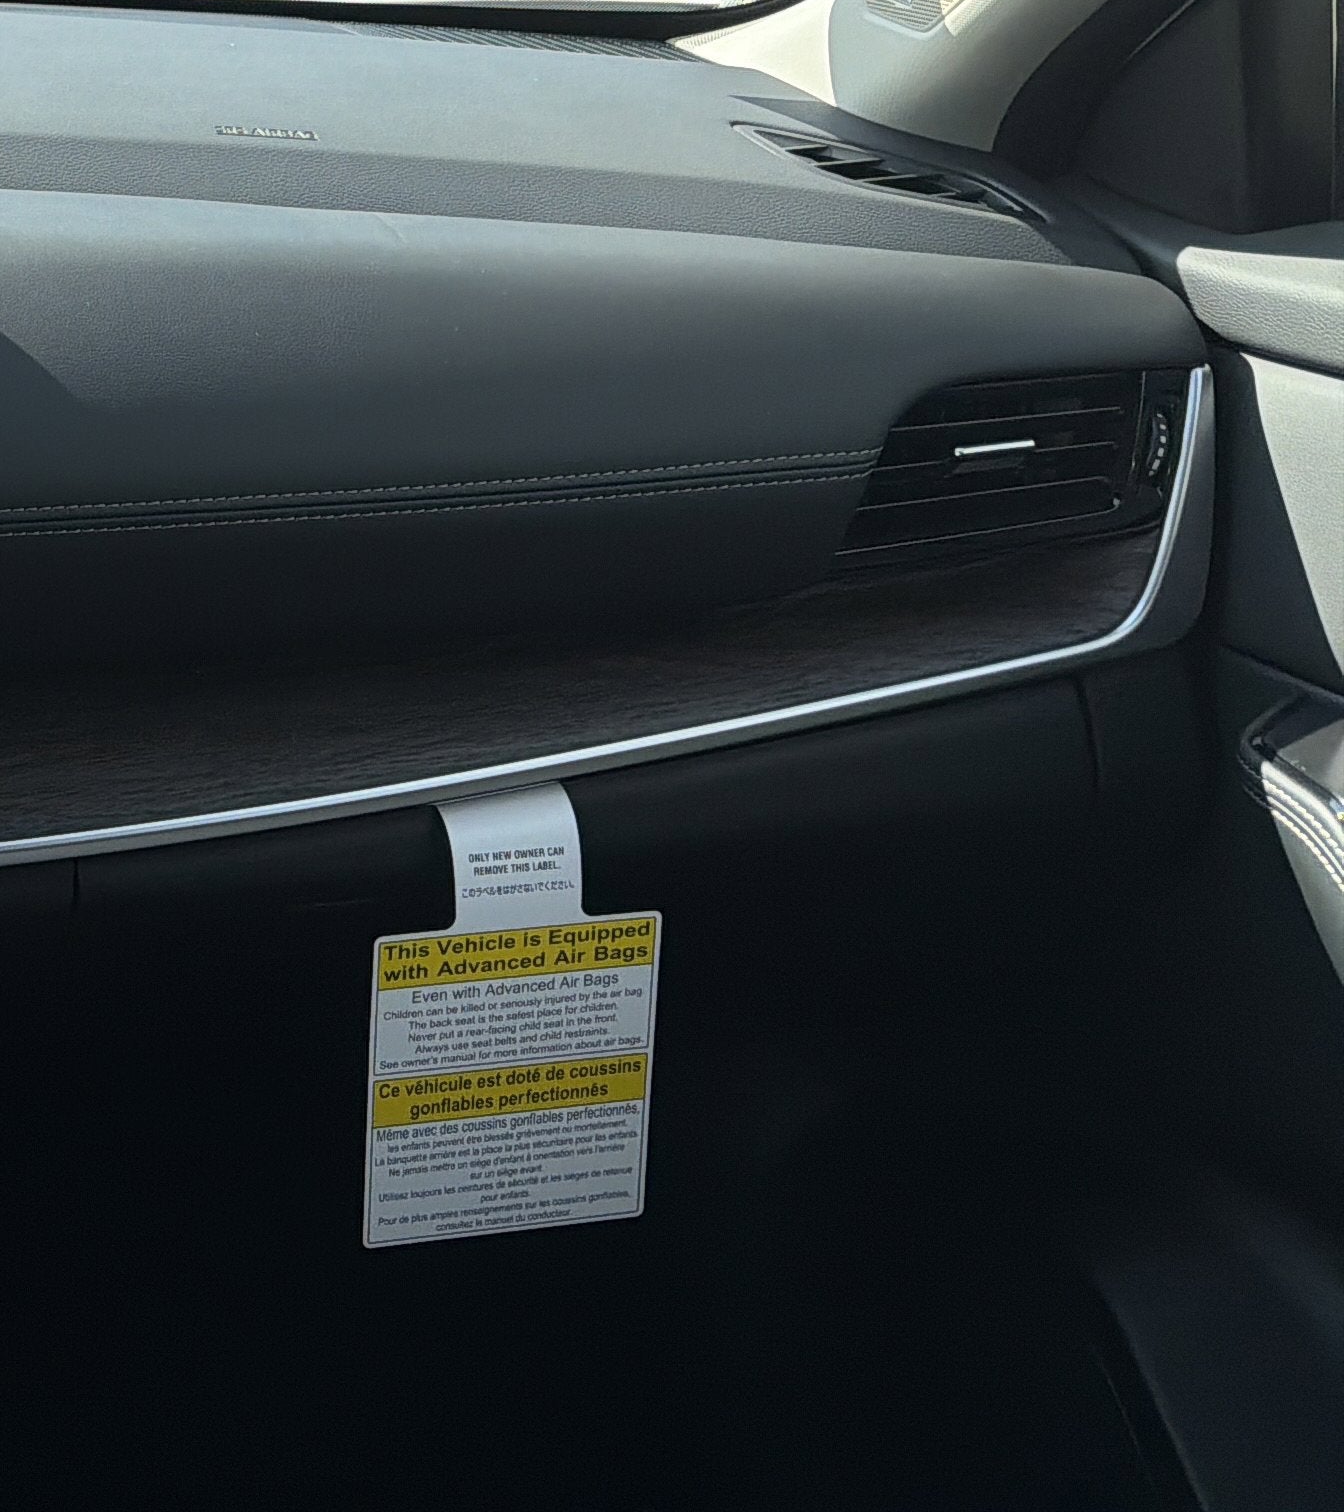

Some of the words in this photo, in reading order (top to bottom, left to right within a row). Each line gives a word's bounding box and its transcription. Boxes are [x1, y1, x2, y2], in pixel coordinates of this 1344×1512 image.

[468, 853, 490, 863] ONLY
[493, 851, 511, 861] NEW
[514, 848, 545, 859] OWNER
[547, 846, 564, 856] CAN
[474, 864, 508, 876] REMOVE
[511, 862, 530, 873] THIS
[533, 861, 561, 871] LABEL.
[384, 942, 429, 961] This
[437, 933, 515, 956] Vehicle
[523, 931, 541, 947] is
[548, 921, 650, 948] Equipped
[383, 963, 428, 982] with
[437, 951, 545, 977] Advanced
[553, 948, 585, 966] Air
[593, 941, 648, 965] Bags
[383, 1008, 423, 1020] Children
[425, 1008, 443, 1016] can
[446, 1004, 458, 1014] be
[460, 1001, 485, 1012] killed
[487, 1002, 497, 1010] or
[499, 996, 541, 1011] seriously
[544, 992, 576, 1006] injured
[578, 991, 589, 1003] by
[592, 989, 607, 999] the
[610, 988, 622, 997] air
[411, 988, 447, 1004] Even
[452, 984, 480, 1000] with
[485, 977, 555, 996] Advanced
[559, 975, 578, 989] Air
[583, 971, 618, 990] Bags
[408, 1019, 427, 1030] The
[429, 1017, 452, 1028] back
[454, 1014, 475, 1025] seat
[478, 1013, 485, 1023] is
[488, 1012, 503, 1022] the
[506, 1008, 534, 1020] safest
[536, 1006, 562, 1019] place
[564, 1004, 577, 1014] for
[379, 1059, 398, 1069] See
[400, 1055, 437, 1067] owner's
[440, 1051, 475, 1063] manual
[478, 1049, 490, 1059] for
[493, 1049, 517, 1057] more
[520, 1041, 572, 1055] information
[575, 1038, 602, 1049] about
[603, 1036, 616, 1046] air
[378, 1082, 400, 1099] Ce
[405, 1074, 472, 1096] véhicule
[476, 1071, 501, 1088] est
[505, 1067, 541, 1085] doté
[545, 1064, 565, 1081] de
[569, 1056, 641, 1079] coussins
[410, 1092, 493, 1120] gonflables
[498, 1080, 608, 1110] perfectionnés
[376, 1126, 409, 1142] Même
[411, 1126, 437, 1138] avec
[439, 1121, 458, 1135] des
[461, 1116, 507, 1132] coussins
[509, 1109, 563, 1129] gonflables
[566, 1101, 640, 1123] perfectionnés,
